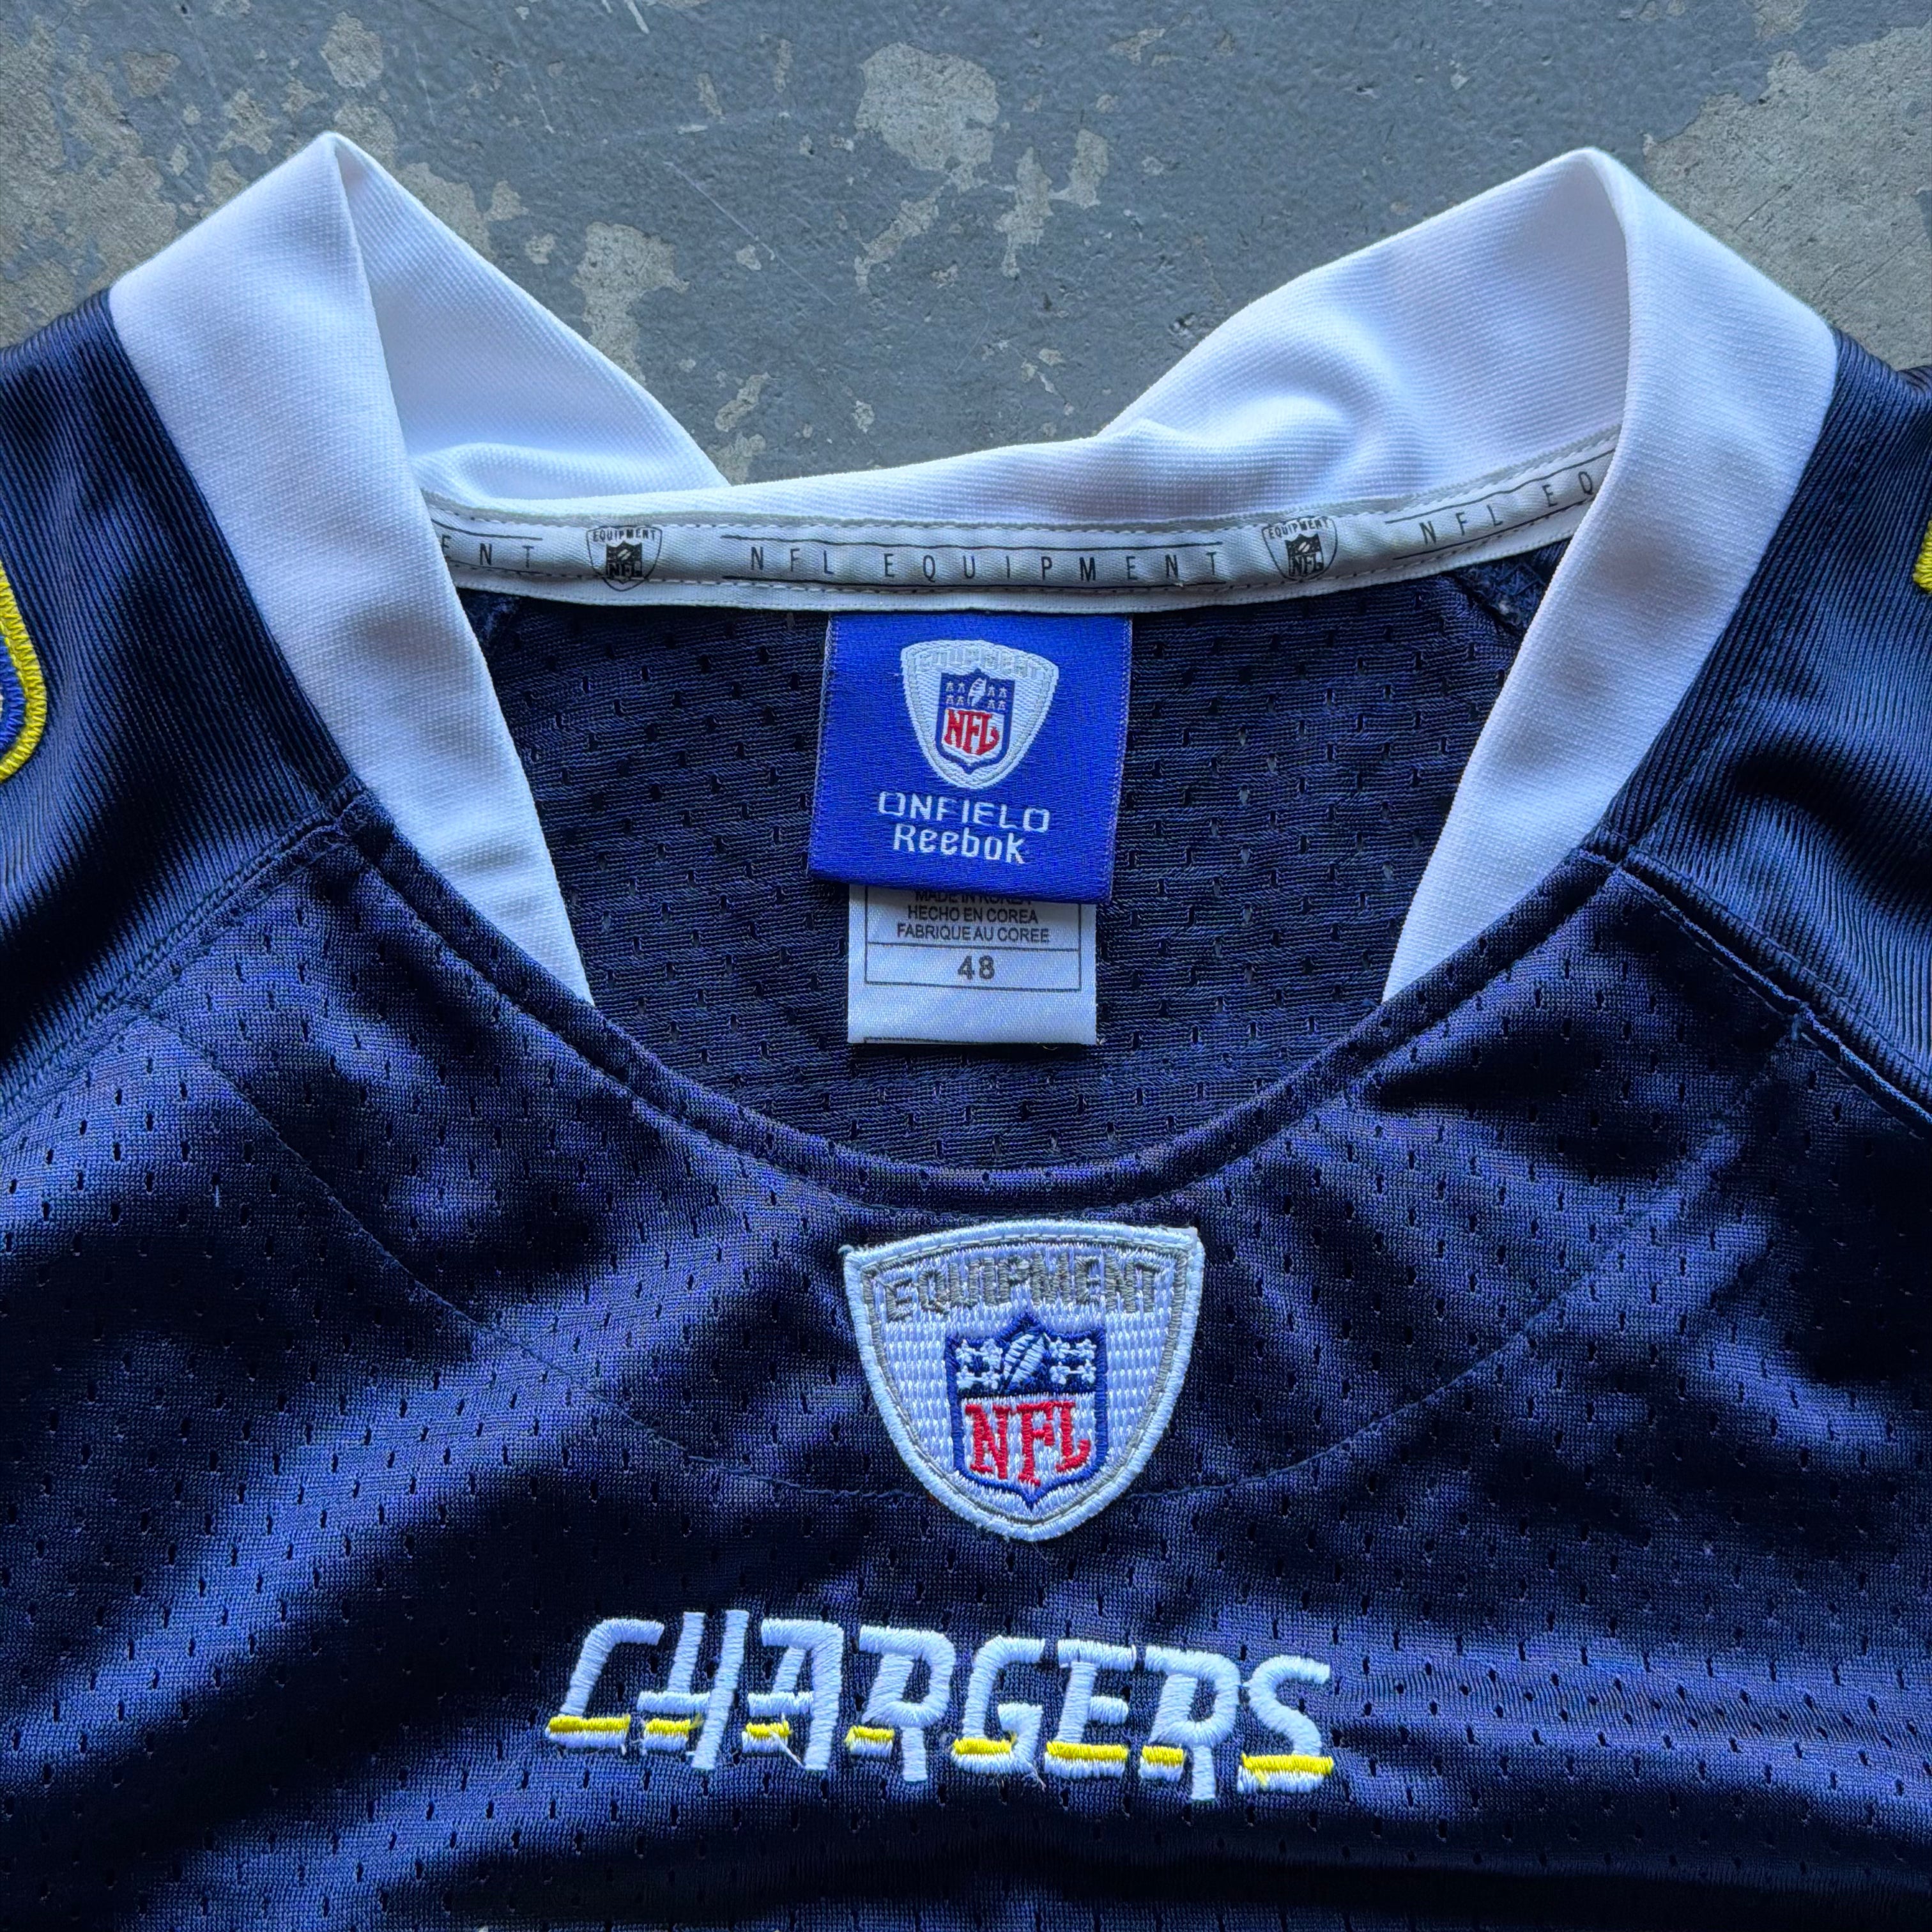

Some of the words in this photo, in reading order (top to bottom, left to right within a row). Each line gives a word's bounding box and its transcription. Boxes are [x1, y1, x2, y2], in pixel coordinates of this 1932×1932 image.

[592, 528, 656, 543] EQUIPMENT
[1268, 518, 1329, 539] EQUIPMENT
[1418, 504, 1503, 545] NFL
[606, 562, 642, 577] NFL
[750, 546, 834, 575] NFL
[884, 551, 1218, 581] EQUIPMENT
[1290, 552, 1324, 577] NFL
[944, 708, 1000, 756] NFL
[893, 823, 1025, 864] Reebok
[914, 891, 958, 903] MADE
[978, 894, 1032, 905] KOR
[907, 905, 960, 921] HECHO
[963, 907, 983, 923] EN
[986, 908, 1039, 924] COREA
[896, 923, 971, 941] FABRIQUE
[973, 926, 994, 942] AU
[997, 927, 1050, 943] COREE
[958, 954, 995, 980] 48
[885, 1250, 1163, 1321] EQUIPMENT
[965, 1400, 1091, 1487] NFL
[545, 1609, 1335, 1802] CHARGERS
